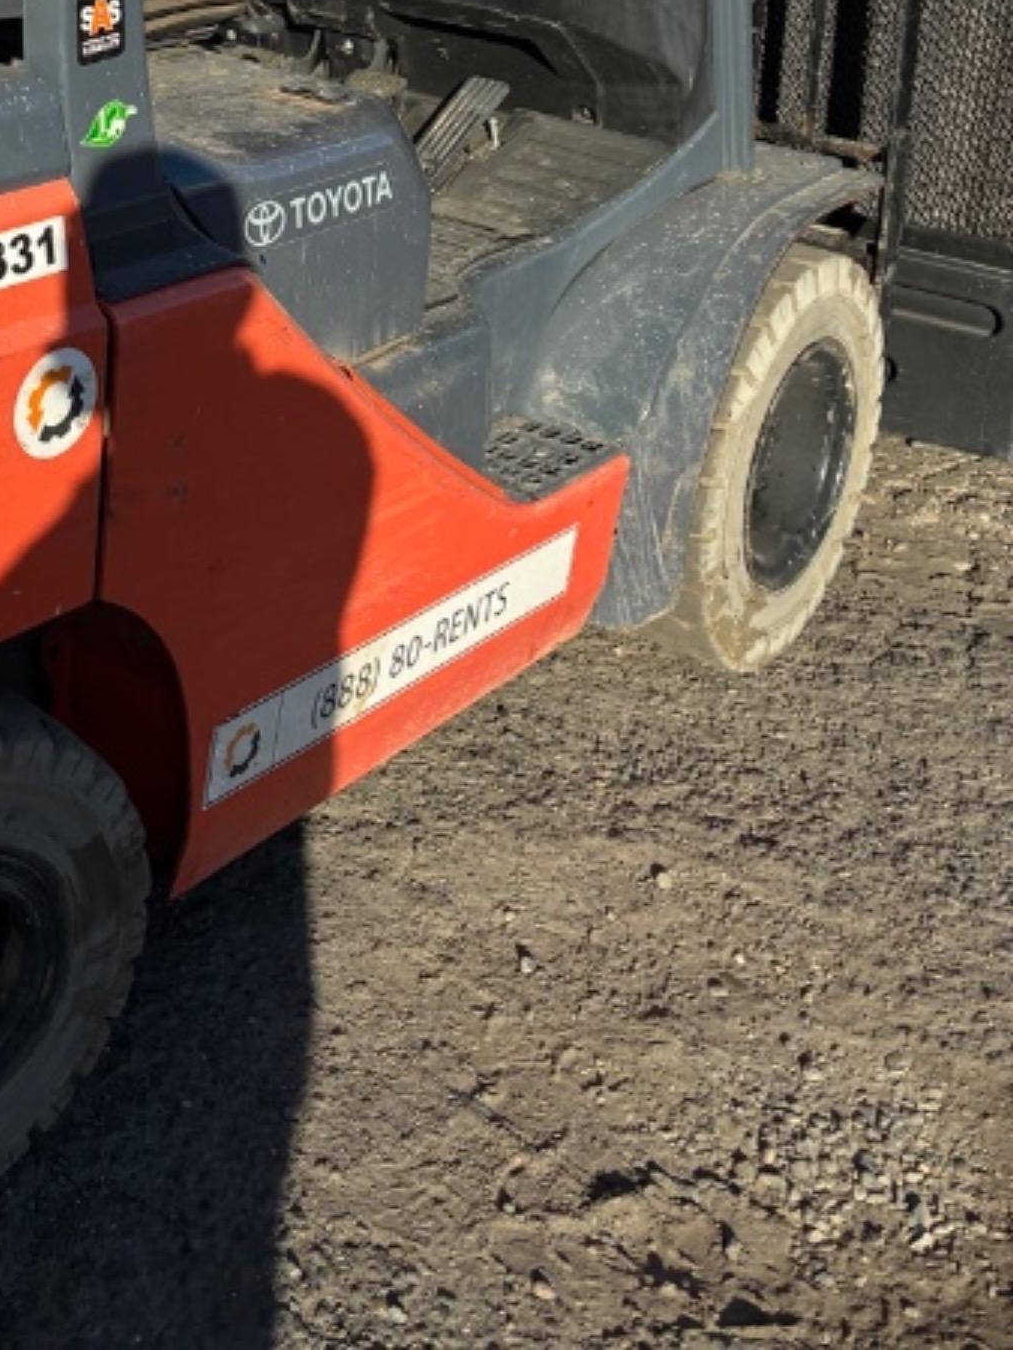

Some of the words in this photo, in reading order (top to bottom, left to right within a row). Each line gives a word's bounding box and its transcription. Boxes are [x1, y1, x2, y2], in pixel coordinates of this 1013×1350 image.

[289, 169, 394, 230] TOYOTA
[309, 655, 381, 731] (888)
[387, 580, 511, 680] 80-RENTS
